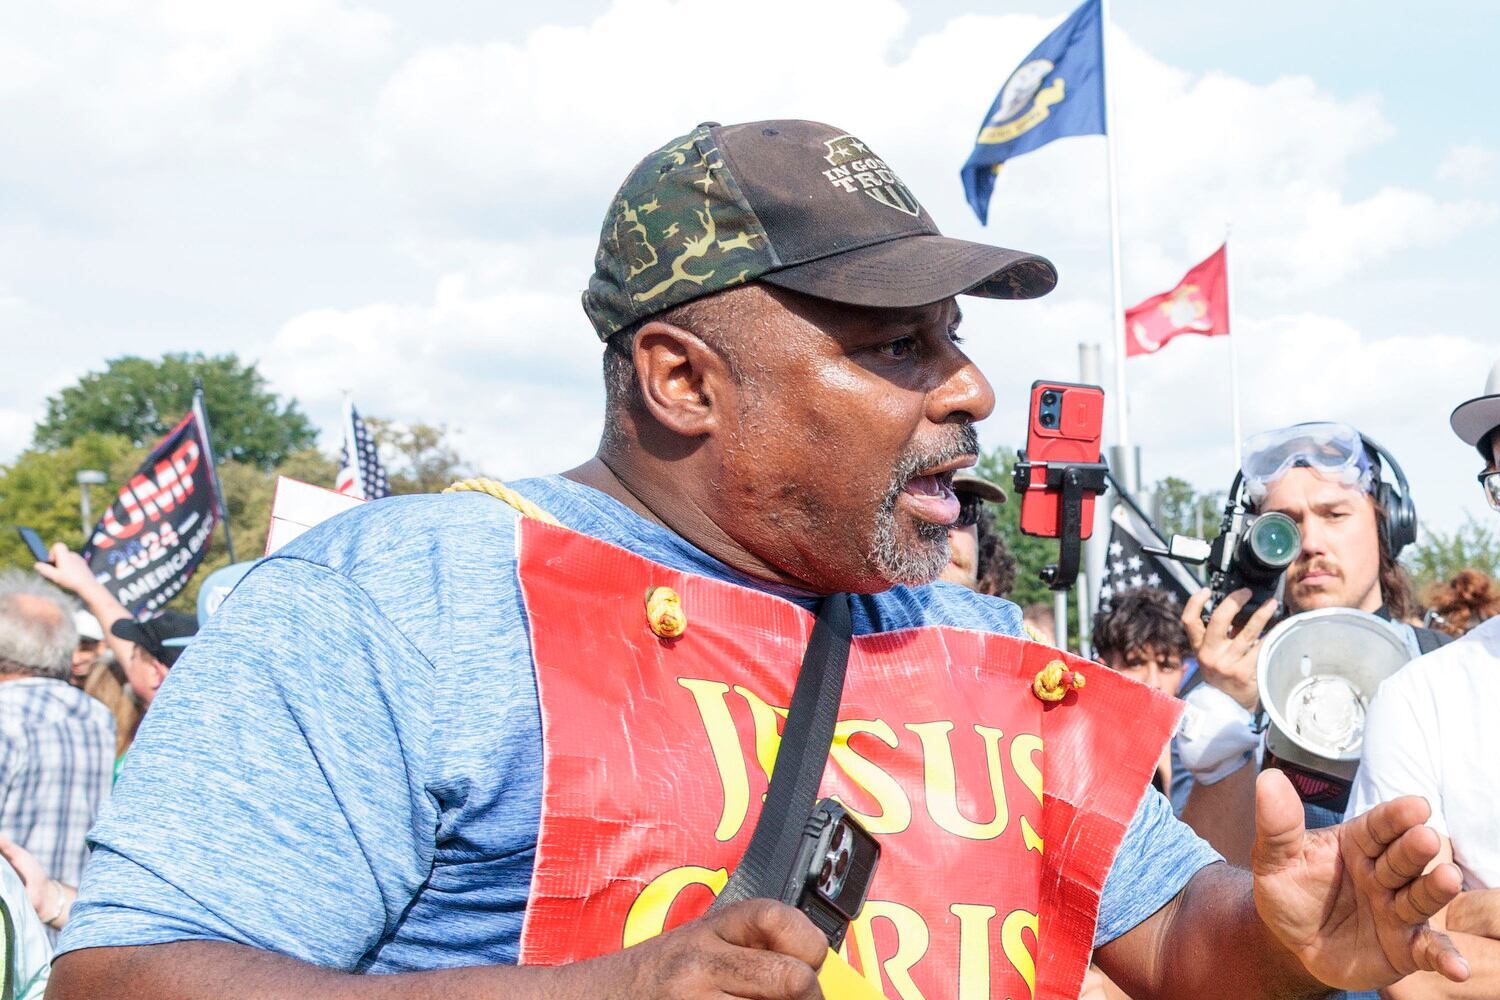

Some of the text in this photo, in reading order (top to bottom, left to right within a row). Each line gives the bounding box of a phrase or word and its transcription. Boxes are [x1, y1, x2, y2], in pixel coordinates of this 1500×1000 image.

[822, 165, 851, 180] IN
[107, 522, 180, 580] 2024
[118, 547, 193, 606] AMERICA
